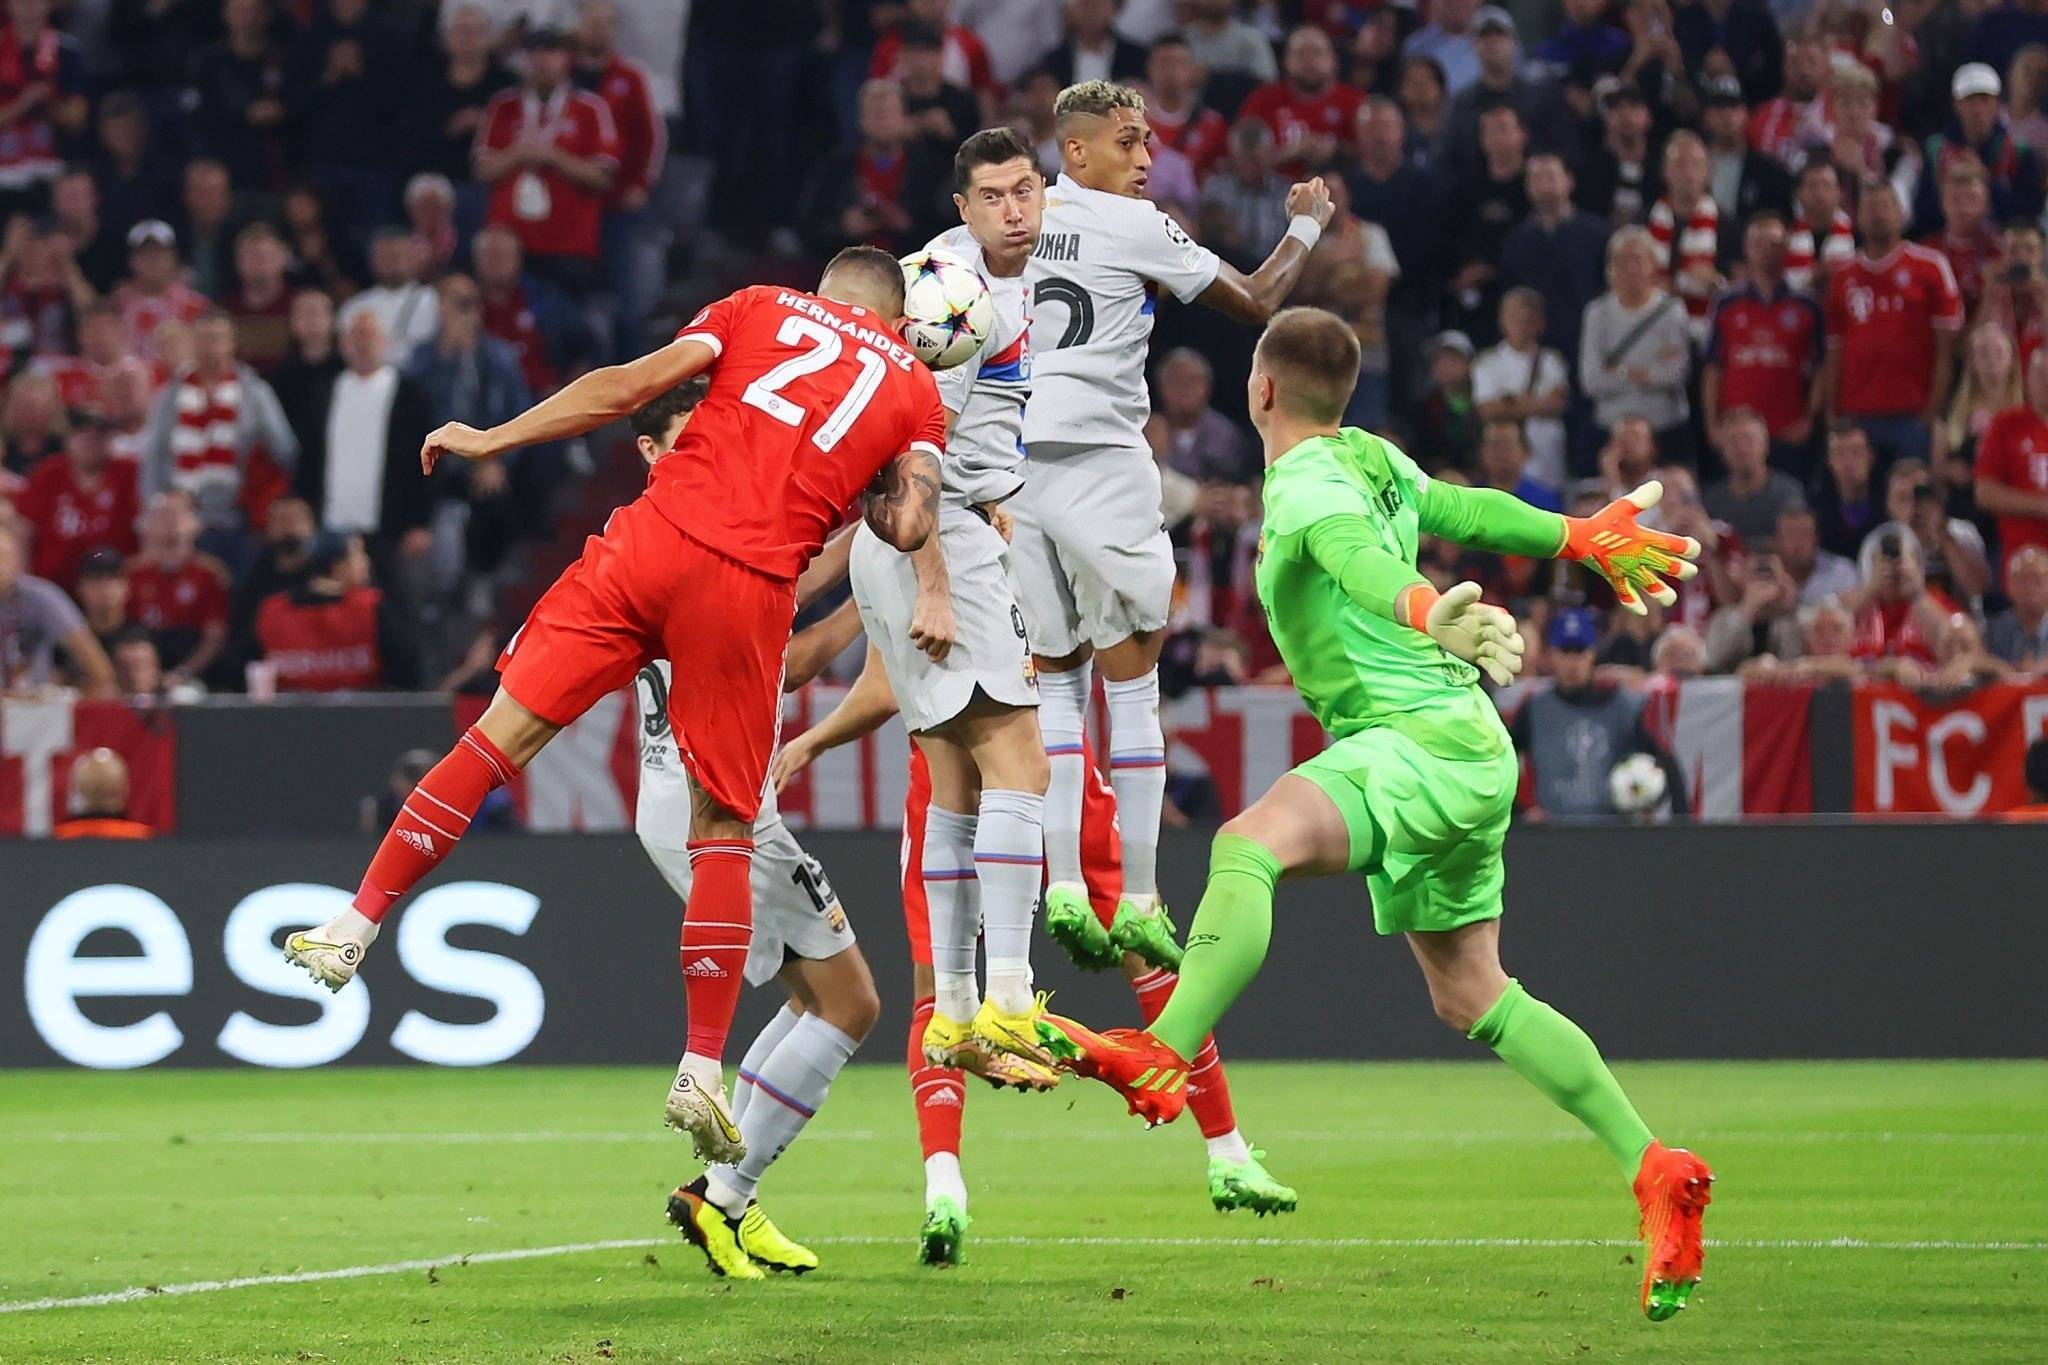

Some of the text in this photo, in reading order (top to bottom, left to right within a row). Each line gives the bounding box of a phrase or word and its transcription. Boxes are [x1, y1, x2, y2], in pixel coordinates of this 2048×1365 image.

[1035, 233, 1081, 261] INHA
[776, 291, 916, 373] HERNÁNDEZ
[740, 315, 887, 454] 21
[1872, 700, 1992, 819] FC
[396, 828, 438, 859] adidas
[24, 881, 545, 1069] ess
[683, 966, 728, 978] adidas
